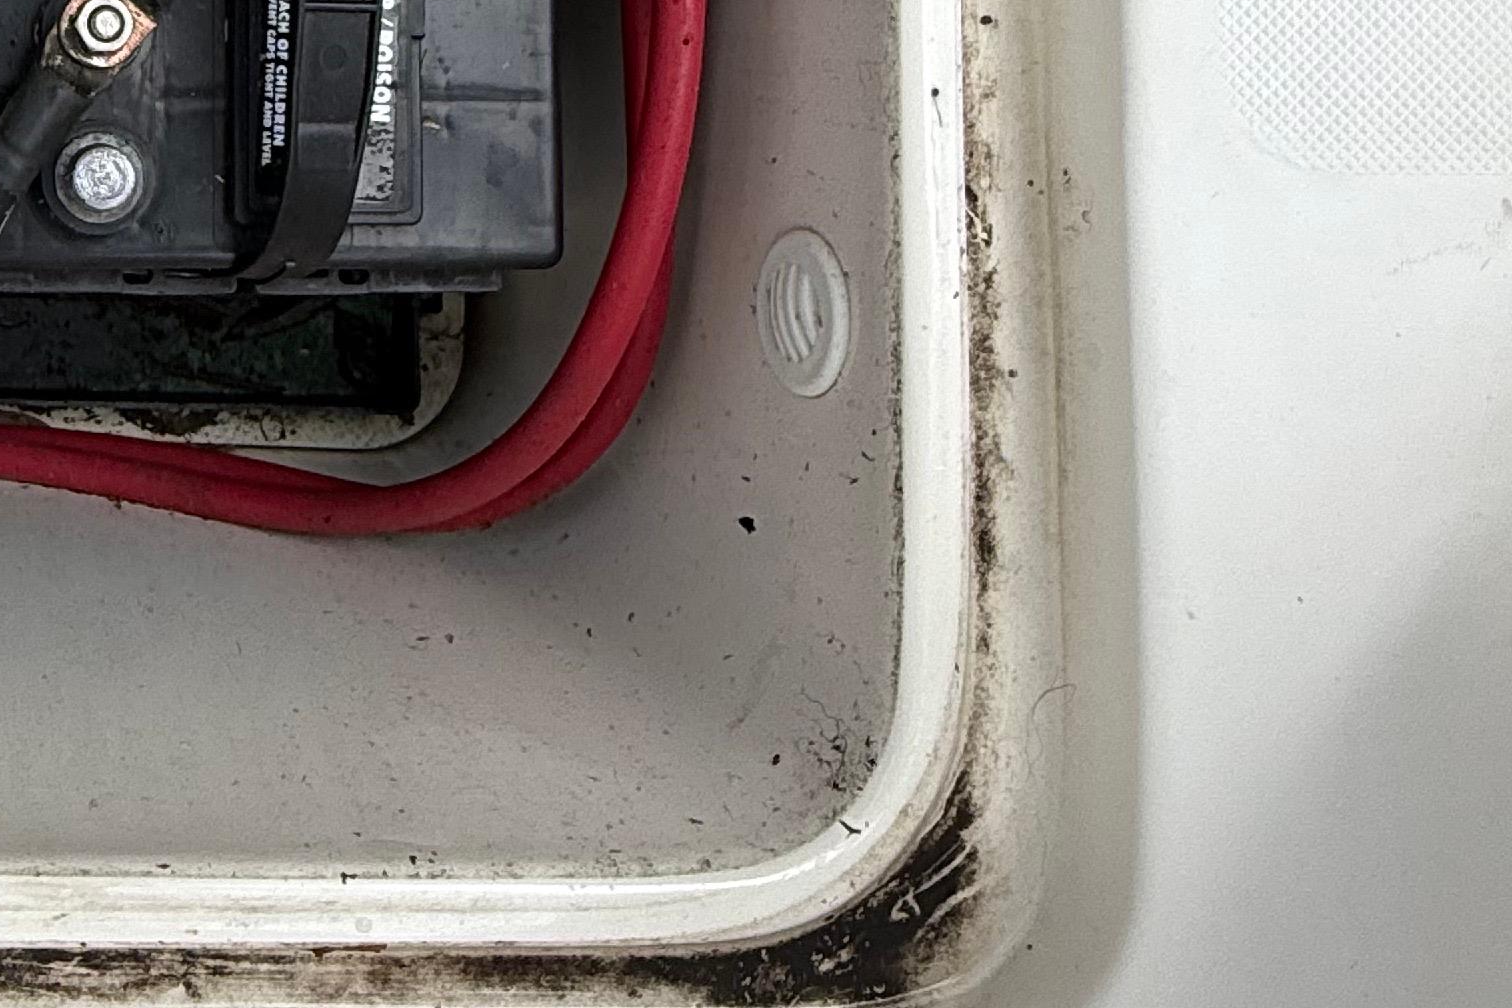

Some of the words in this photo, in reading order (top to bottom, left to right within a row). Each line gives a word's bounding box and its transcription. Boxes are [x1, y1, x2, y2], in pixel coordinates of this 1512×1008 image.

[265, 29, 277, 60] CAPS
[276, 38, 289, 61] OF
[264, 62, 275, 98] TIGHT
[262, 100, 274, 128] AND
[272, 64, 288, 147] CHILDREN
[261, 130, 273, 167] LEVEL
